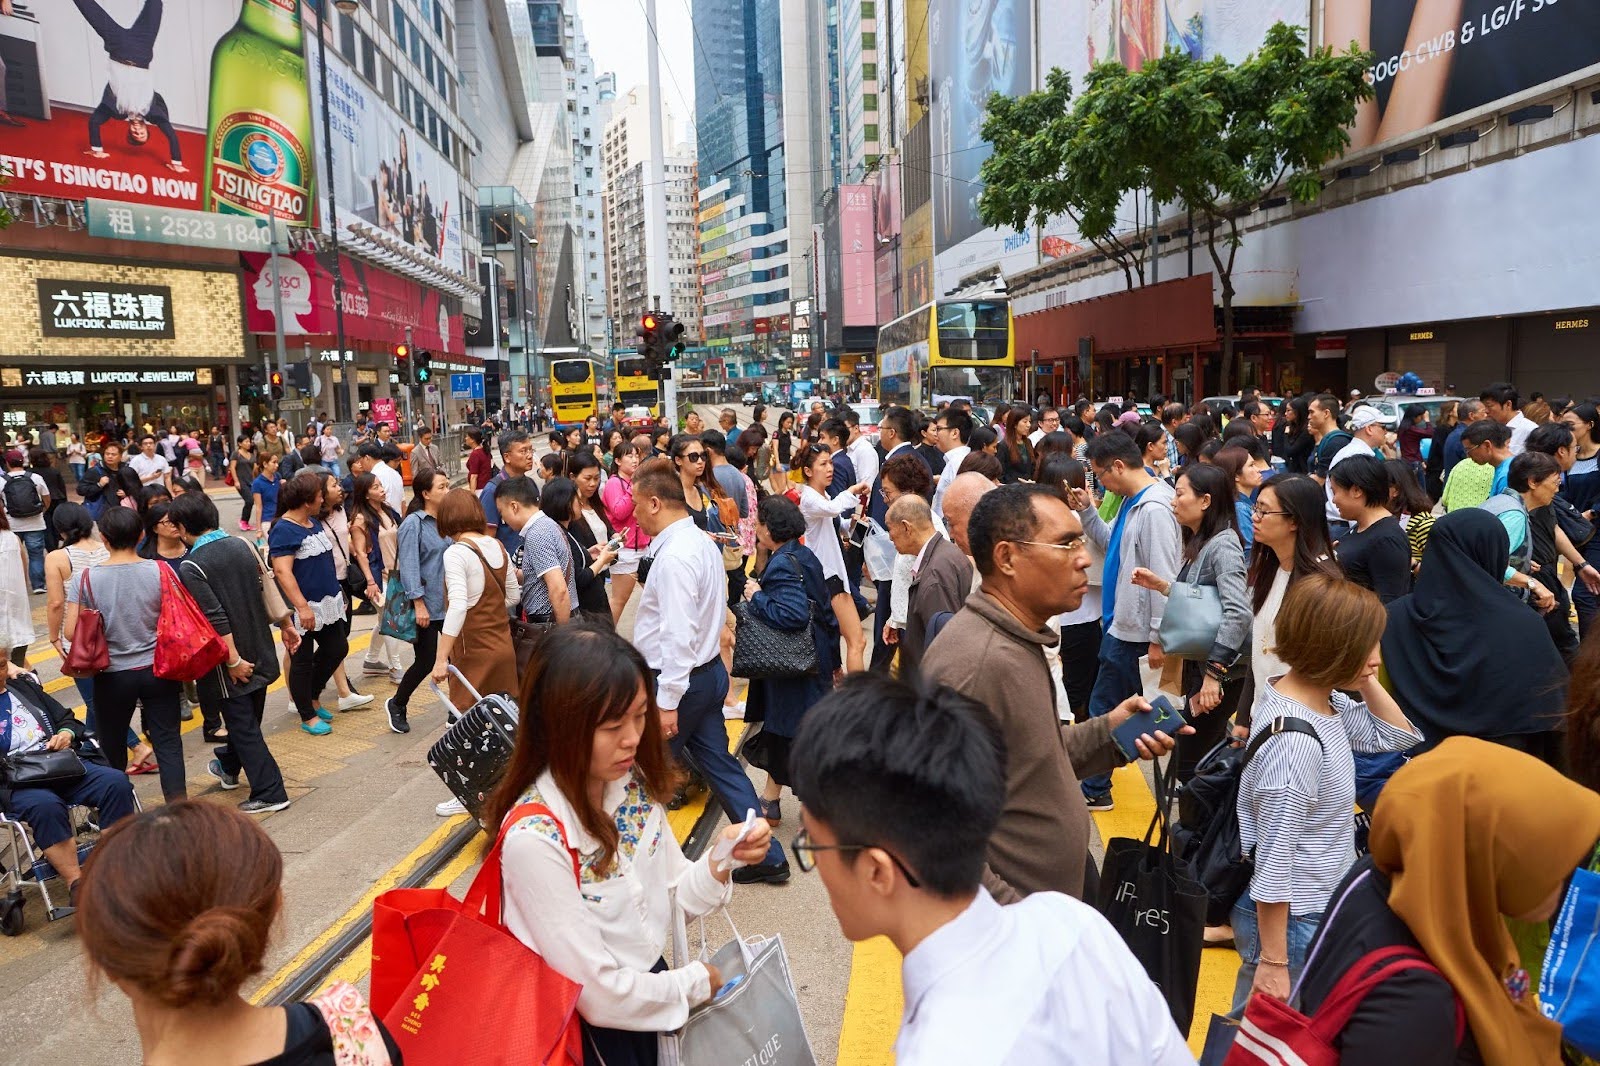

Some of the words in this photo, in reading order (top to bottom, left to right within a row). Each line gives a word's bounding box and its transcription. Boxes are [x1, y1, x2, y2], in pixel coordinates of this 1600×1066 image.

[1367, 50, 1411, 86] SOGO
[1415, 30, 1456, 64] CWB
[1460, 21, 1475, 45] &
[1480, 0, 1527, 36] LG/F
[50, 161, 147, 195] TSINGTAO
[152, 176, 198, 200] NOW
[216, 167, 303, 215] TSINGTAO
[161, 215, 217, 240] 2523
[222, 222, 272, 246] 1840
[1004, 227, 1031, 253] PHILIPS
[51, 289, 164, 321] 六福珠寶
[54, 318, 105, 330] LUKFOOK
[107, 319, 165, 331] JEWELLERY
[26, 371, 85, 386] 六福珠寶
[91, 371, 139, 384] LUKFOOK
[140, 371, 195, 383] JEWELLERY
